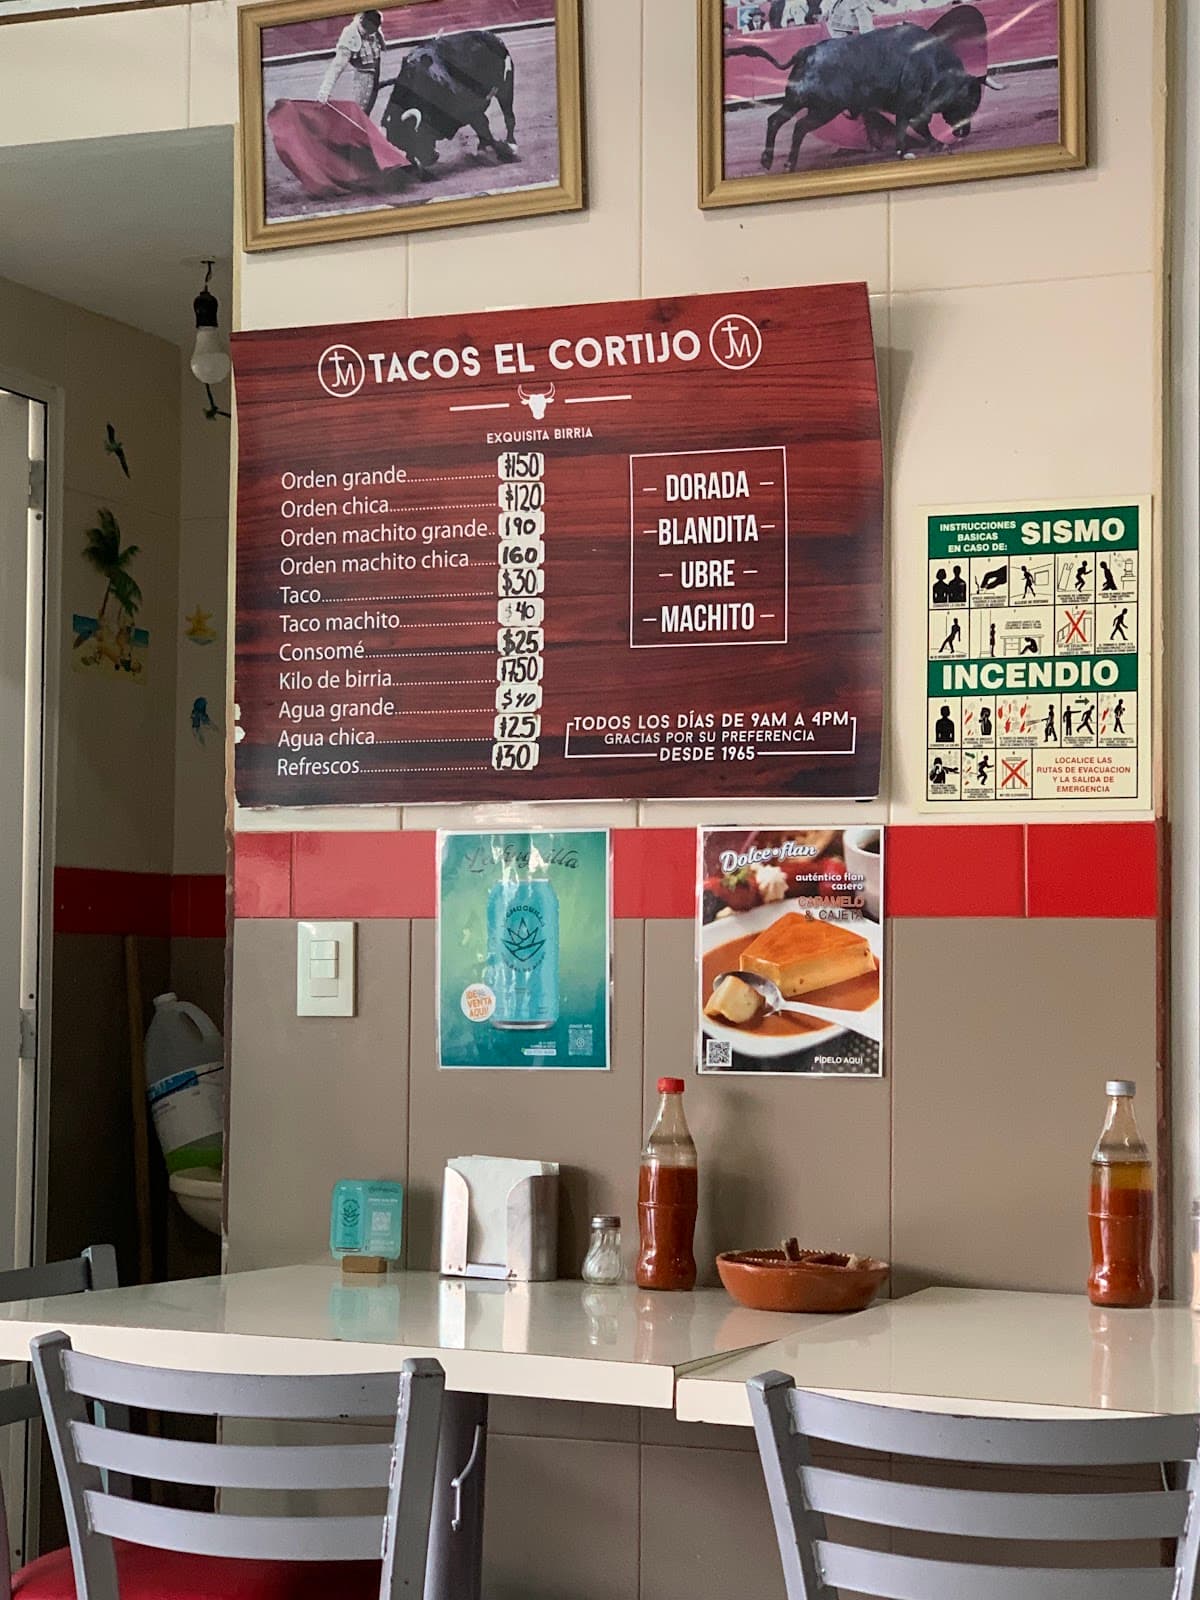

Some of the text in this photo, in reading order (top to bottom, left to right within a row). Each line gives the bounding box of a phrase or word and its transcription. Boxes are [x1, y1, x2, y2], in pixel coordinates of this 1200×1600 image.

[368, 330, 701, 384] TACOS EL CORTIJO
[486, 427, 593, 444] EXQUISITA BIRRIA
[504, 453, 539, 478] $150
[281, 465, 407, 491] Orden grande
[666, 471, 750, 502] DORADA
[505, 484, 542, 511] $120
[281, 498, 389, 519] Orden chica
[281, 519, 488, 547] Orden machito grande
[504, 517, 537, 537] 190
[658, 514, 759, 546] BLANDITA
[939, 521, 1017, 532] INSTRUCCIONES
[957, 532, 998, 542] BASICAS
[1021, 517, 1125, 545] SISMO
[502, 546, 538, 566] 160
[948, 542, 1008, 553] EN CASO DE:
[281, 549, 470, 576] Orden machito chica
[502, 568, 537, 596] $30
[680, 559, 735, 589] UBRE
[280, 586, 321, 605] Taco
[280, 611, 401, 633] Taco machito
[661, 602, 755, 633] MACHITO
[279, 641, 365, 662] Consomé
[502, 630, 539, 656] $25
[279, 668, 393, 690] Kilo de birria
[943, 660, 1119, 690] INCENDIO
[278, 698, 395, 723] Agua grande
[573, 710, 849, 731] TODOS LOS DÍAS DE 9AM A 4PM
[278, 727, 375, 752] Agua chica
[604, 730, 815, 745] GRACIAS POR SU PREFERENCIA
[659, 745, 755, 762] DESDE 1965
[1054, 756, 1113, 765] LOCALICE LAS
[277, 758, 360, 777] Refrescos
[1036, 766, 1131, 774] RUTAS DE EVACUACION
[1056, 785, 1110, 793] EMERGENCIA
[1072, 776, 1101, 784] SALIDA
[1103, 775, 1115, 783] DE
[795, 872, 864, 882] auténtico flan
[831, 882, 864, 891] casero
[798, 895, 865, 908] CARAMELO
[804, 909, 864, 921] & CAJETA
[467, 997, 493, 1010] VENTA
